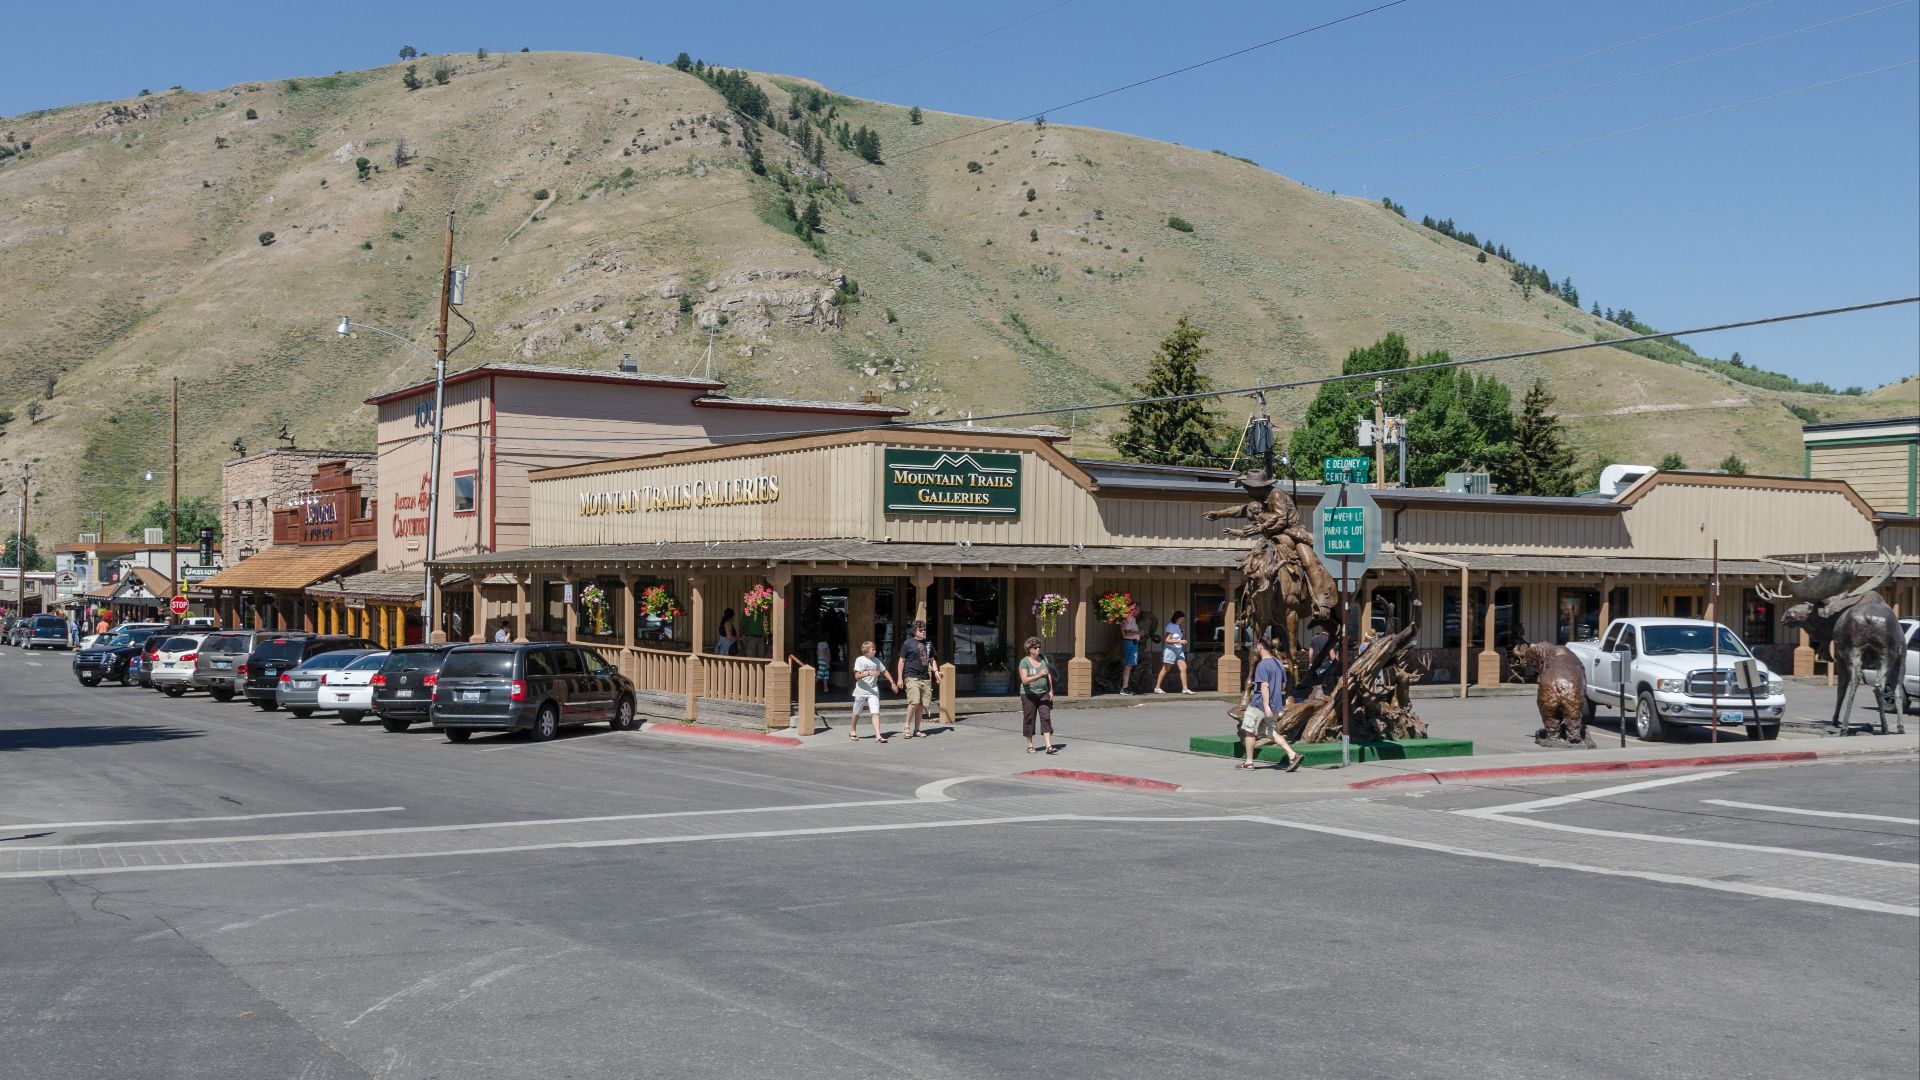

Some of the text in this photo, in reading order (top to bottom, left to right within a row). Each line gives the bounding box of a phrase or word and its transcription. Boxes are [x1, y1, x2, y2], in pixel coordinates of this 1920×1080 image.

[1326, 460, 1331, 469] E
[1332, 459, 1360, 469] DELONEY
[893, 470, 1013, 488] MOUNTAIN TRAILS
[1326, 472, 1352, 482] CENTER
[579, 475, 780, 516] MOUNTAIN TRAILS GALLERIES
[917, 488, 990, 504] GALLERIES
[1351, 526, 1363, 536] LOT
[171, 601, 187, 609] STOP
